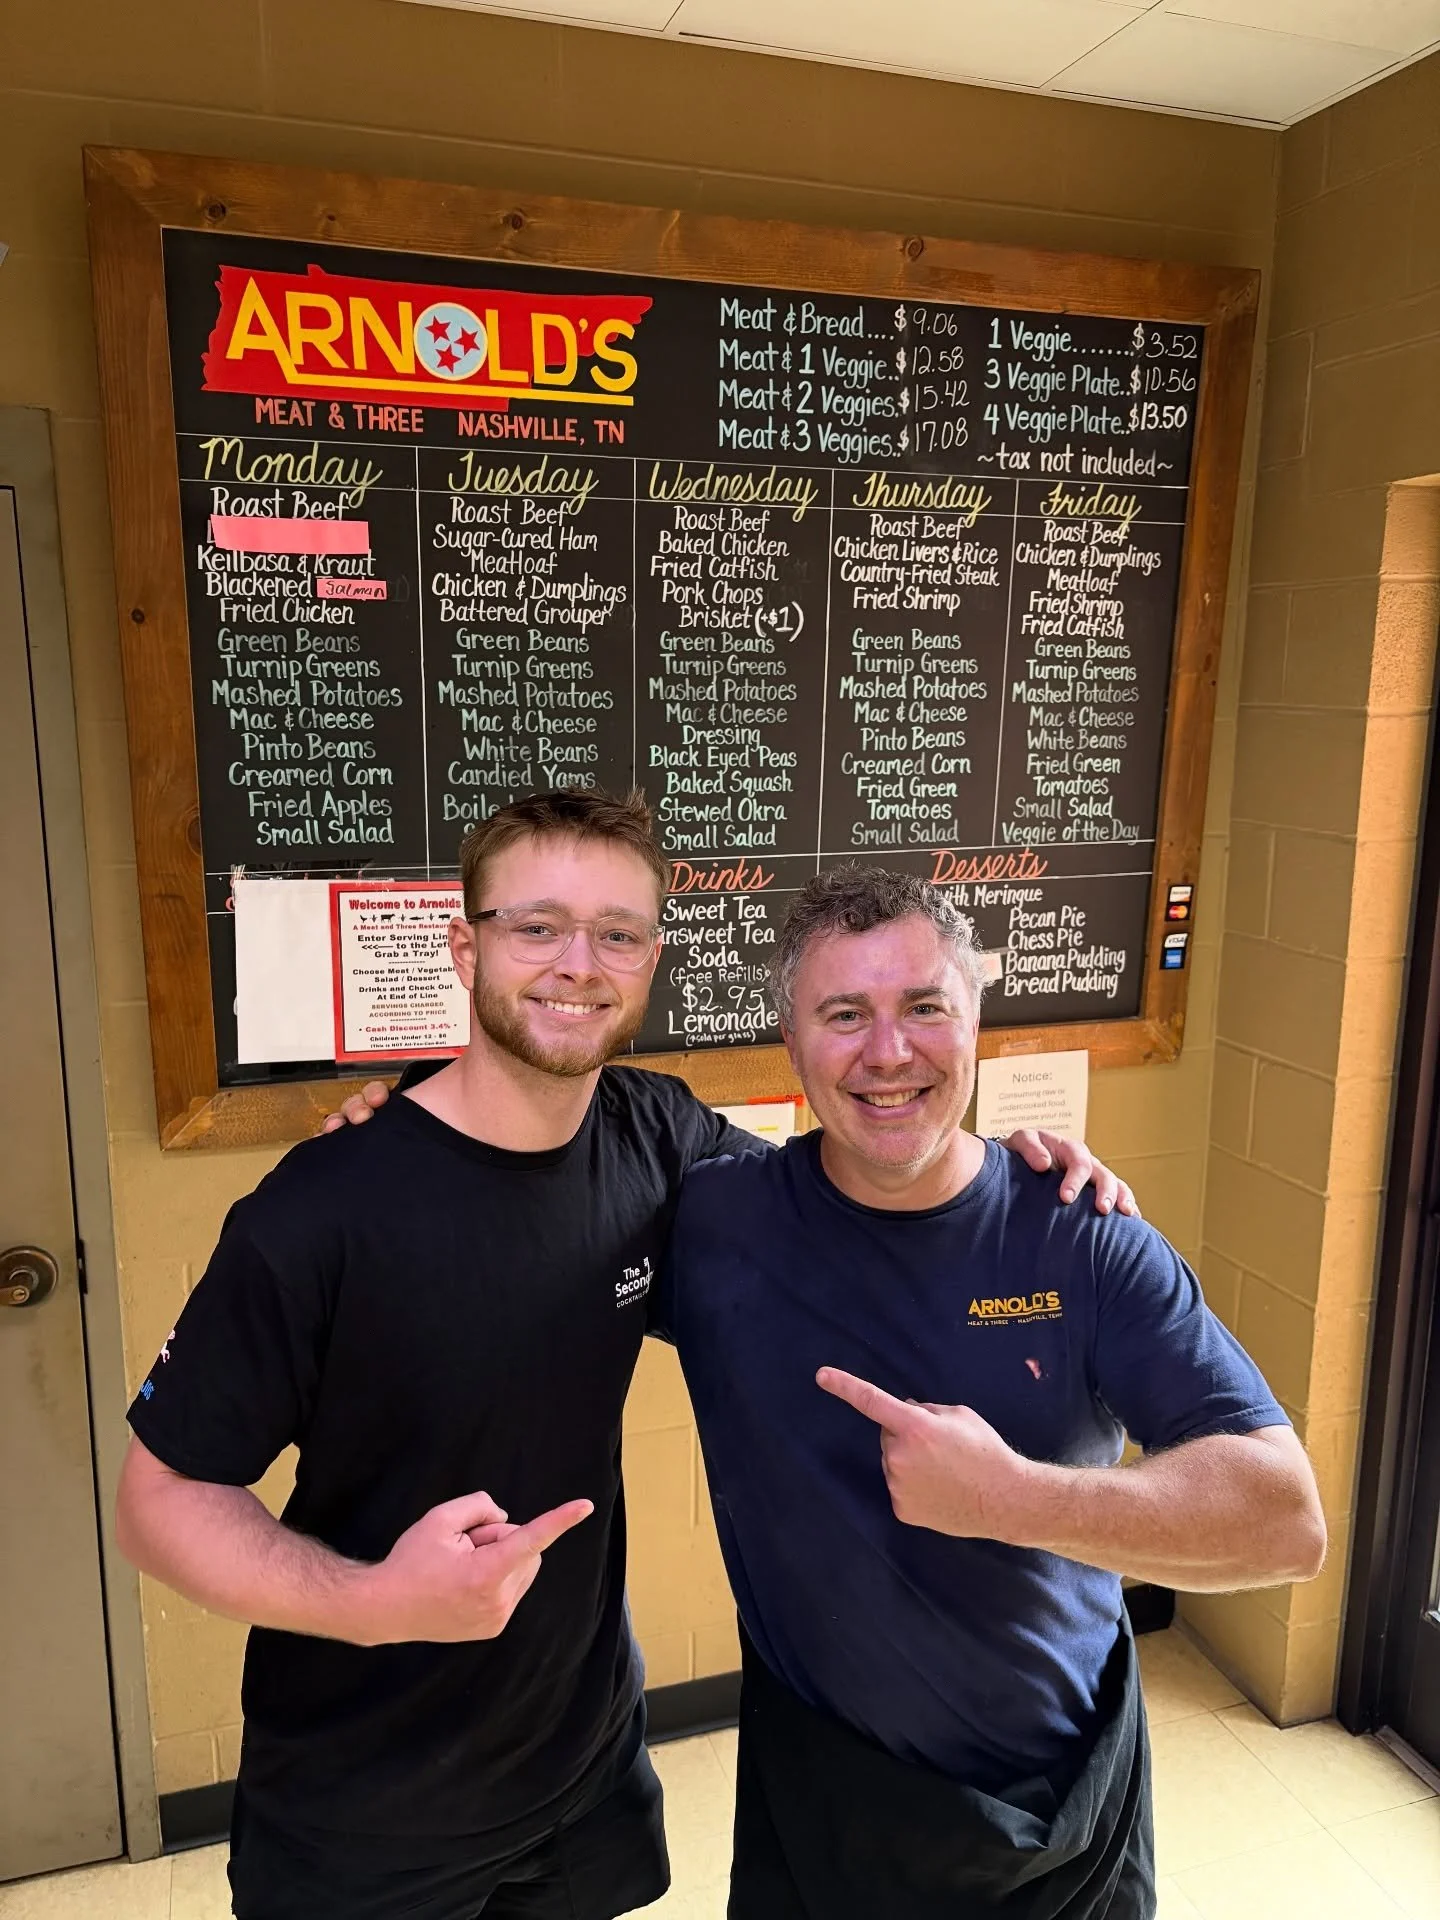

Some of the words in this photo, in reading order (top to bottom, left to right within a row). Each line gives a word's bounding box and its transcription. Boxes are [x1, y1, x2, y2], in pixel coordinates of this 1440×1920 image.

[720, 298, 777, 332] Meat
[783, 303, 798, 336] &
[225, 276, 638, 396] ARNOLD'S
[988, 317, 1002, 349] 1
[719, 339, 779, 373] Meat
[781, 342, 793, 373] &
[798, 343, 815, 374] 1
[984, 358, 1001, 389] 3
[1007, 361, 1066, 402] Veggie
[718, 378, 780, 410] Meat
[781, 381, 793, 412] &
[796, 381, 814, 414] 2
[255, 397, 316, 428] MEAT
[327, 402, 346, 430] &
[352, 404, 425, 433] THREE
[457, 411, 586, 446] NASHVILLE,
[593, 420, 625, 444] TN
[718, 416, 778, 450] Meat
[779, 423, 791, 450] &
[792, 419, 811, 451] 3
[983, 403, 1000, 436] 4
[1004, 402, 1067, 443] Veggie
[199, 437, 384, 508] Monday
[1040, 443, 1074, 473] not
[448, 450, 600, 516] Tuesday
[649, 462, 819, 523] Wednesday
[210, 486, 285, 518] Roast
[291, 491, 349, 520] Beef
[852, 471, 993, 529] Thursday
[1040, 481, 1142, 536] Friday
[433, 523, 554, 558] Sugar-Cured
[559, 526, 598, 551] Ham
[834, 535, 899, 561] Chicken
[902, 539, 950, 564] Livers
[962, 541, 999, 565] Rice
[313, 548, 376, 577] Kraut
[471, 548, 558, 576] Meatloaf
[840, 559, 952, 592] Country-Fried
[954, 563, 1000, 587] Steak
[205, 572, 313, 598] Blackened
[431, 572, 508, 598] Chicken
[515, 575, 526, 600] &
[530, 572, 627, 612] Dumplings
[662, 579, 707, 606] Pork
[712, 580, 764, 610] Chops
[1047, 568, 1119, 595] Meatloaf
[440, 598, 529, 626] Battered
[534, 599, 611, 635] Grouper
[678, 605, 753, 629] Brisket
[754, 601, 804, 642] (+$1)
[1021, 614, 1064, 637] Fried
[1067, 615, 1125, 639] Catfish
[1029, 706, 1064, 727] Mac
[1079, 706, 1135, 729] Cheese
[682, 725, 761, 752] Dressing
[228, 761, 335, 787] Creamed
[342, 761, 393, 785] Corn
[649, 744, 702, 769] Black
[707, 744, 751, 774] Eyed
[758, 746, 797, 768] Peas
[448, 761, 534, 788] Candied
[542, 763, 596, 789] Yams
[248, 790, 314, 818] Fried
[321, 789, 393, 825] Apples
[657, 796, 733, 823] Stewed
[737, 797, 788, 821] Okra
[866, 798, 952, 821] Tomatoes
[1002, 822, 1057, 848] Veggie
[1062, 819, 1080, 843] of
[1080, 820, 1109, 841] the
[1111, 819, 1140, 845] Day
[669, 857, 775, 893] Drinks
[930, 848, 1048, 884] Desserts
[349, 899, 400, 910] Welcome
[404, 899, 415, 909] to
[419, 898, 461, 909] Arnolds
[663, 897, 727, 922] Sweet
[733, 896, 768, 920] Tea
[974, 885, 1043, 908] Meringue
[1009, 907, 1055, 930] Pecan
[1060, 905, 1085, 928] Pie
[358, 934, 386, 942] Enter
[390, 934, 429, 942] Serving
[741, 921, 775, 945] Tea
[1008, 929, 1054, 950] Chess
[1057, 928, 1083, 947] Pie
[413, 950, 439, 959] Tray!
[687, 946, 743, 969] Soda
[1005, 950, 1067, 974] Banana
[1067, 946, 1125, 973] Pudding
[1004, 971, 1059, 996] Bread
[1062, 971, 1118, 998] Pudding
[389, 1024, 428, 1032] Discount
[668, 1003, 779, 1034] Lemonade
[1012, 1072, 1053, 1083] Notice:
[623, 1267, 640, 1280] The
[968, 1291, 1061, 1316] ARNOLD'S
